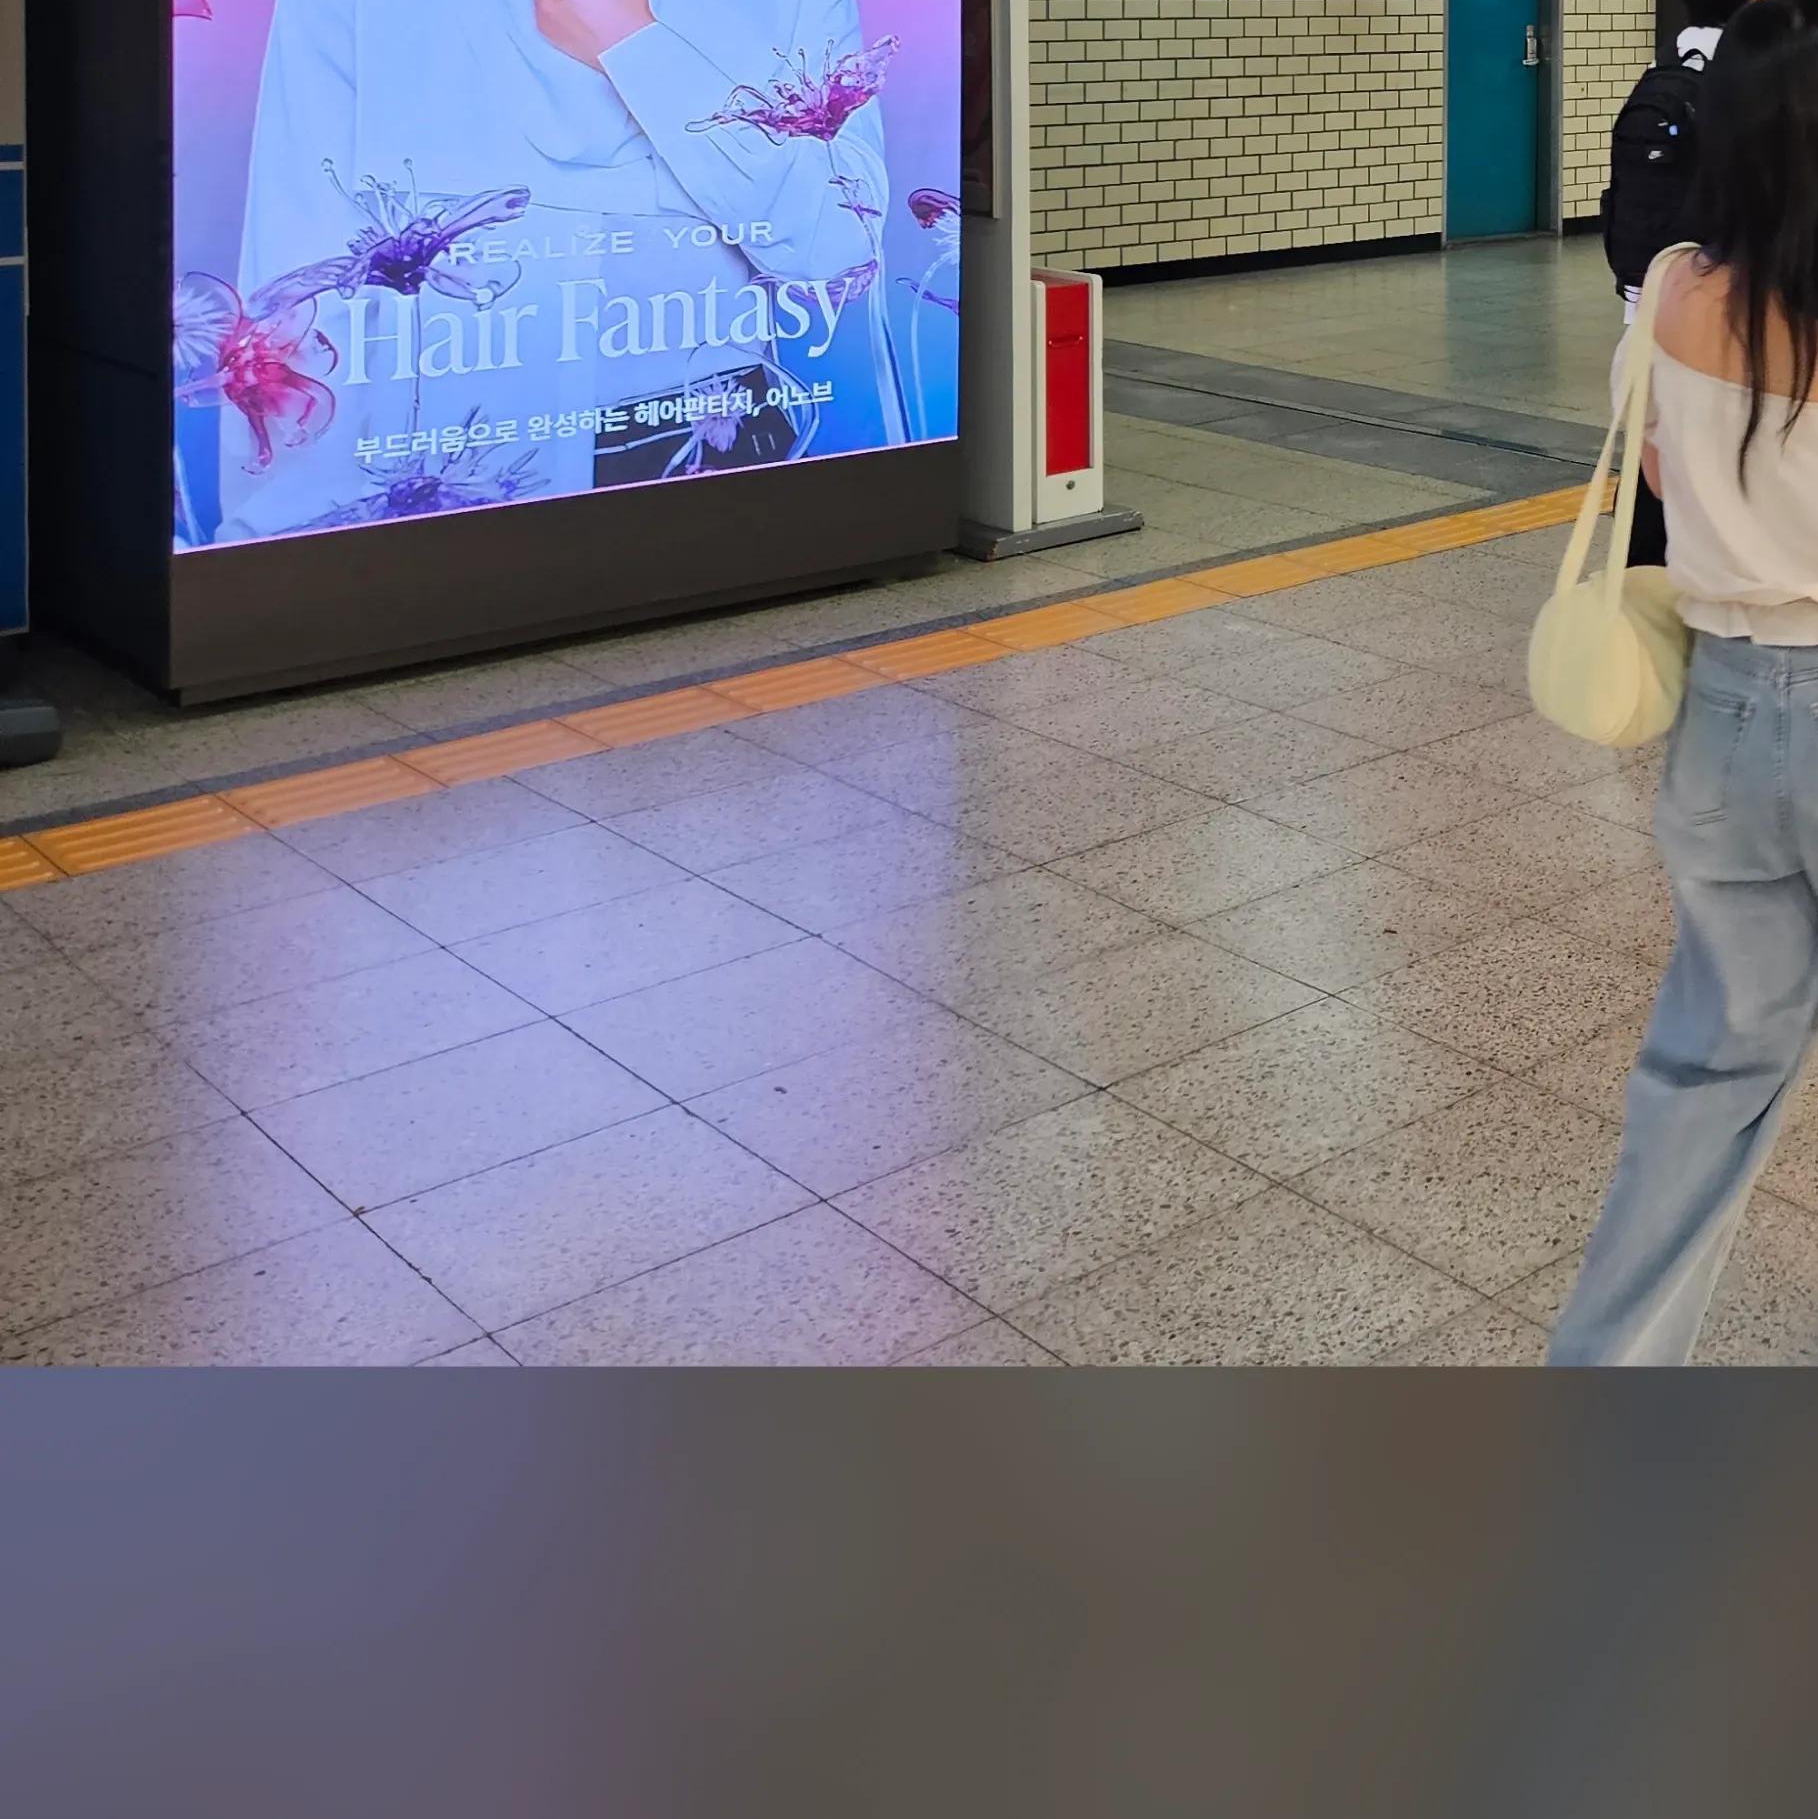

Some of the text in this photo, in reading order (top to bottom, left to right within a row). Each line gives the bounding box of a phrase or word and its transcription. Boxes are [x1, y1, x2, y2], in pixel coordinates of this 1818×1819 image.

[449, 221, 774, 266] REALIZE YOUR
[339, 276, 856, 386] Hair Fantasy
[353, 380, 835, 464] 부드러움으로 완성하는 헤어판타지, 어노브
